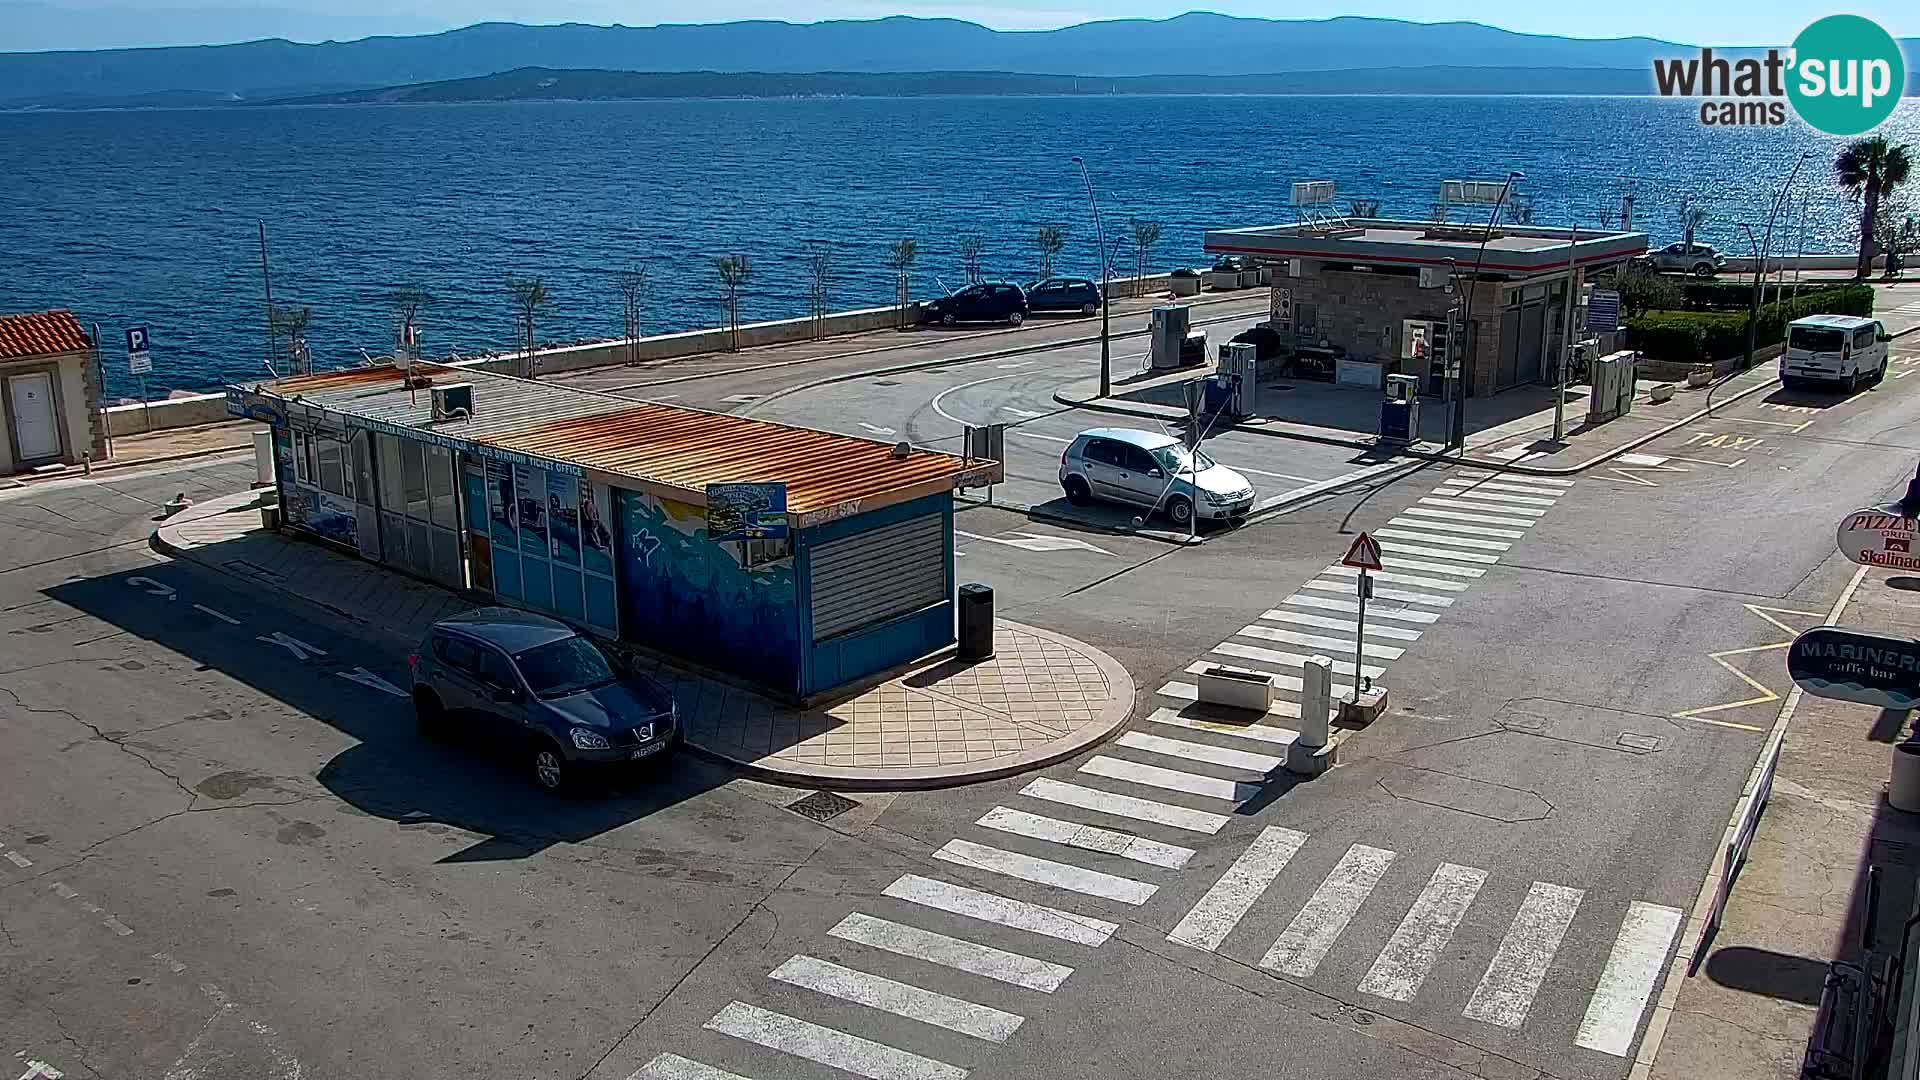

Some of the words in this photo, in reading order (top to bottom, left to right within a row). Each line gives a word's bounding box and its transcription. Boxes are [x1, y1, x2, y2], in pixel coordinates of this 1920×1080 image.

[130, 331, 143, 349] P
[1681, 432, 1764, 451] TAXI
[494, 449, 526, 465] STATION
[528, 457, 554, 470] TICKET
[555, 461, 583, 477] OFFICE
[1847, 515, 1920, 533] PIZZE
[1801, 642, 1920, 673] MARINER
[1828, 662, 1865, 673] caffe
[1870, 665, 1896, 680] bar
